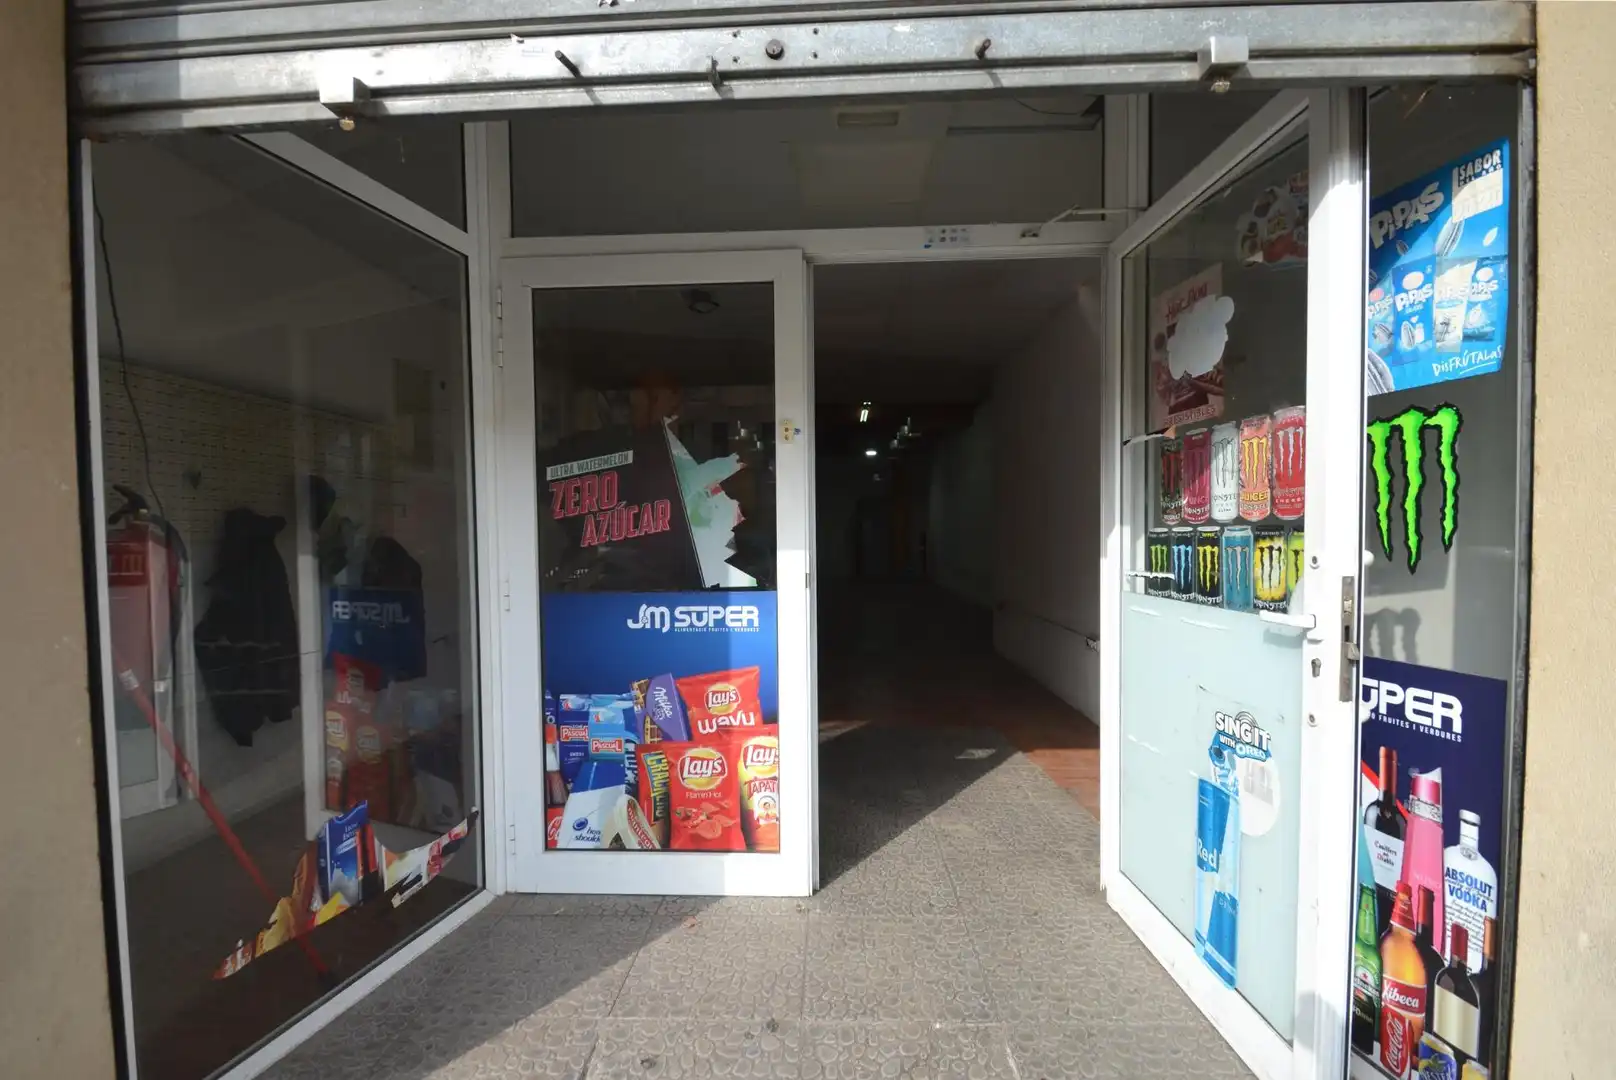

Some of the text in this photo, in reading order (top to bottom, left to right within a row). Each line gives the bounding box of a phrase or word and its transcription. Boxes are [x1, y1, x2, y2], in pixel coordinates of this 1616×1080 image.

[1459, 149, 1501, 181] SABOR
[550, 452, 629, 478] ULTRA WATERMELON
[549, 470, 618, 519] ZERO
[580, 499, 671, 547] AZÚCAR
[674, 605, 760, 627] SUPER
[653, 686, 673, 718] Milka
[708, 688, 737, 708] Lay's
[1361, 677, 1463, 734] UPER
[1215, 711, 1271, 752] SING IT
[1378, 714, 1410, 729] FRUITES
[1419, 725, 1462, 742] VERDURES
[1219, 733, 1267, 761] WITH OREO
[683, 756, 723, 778] Lay's
[1445, 866, 1493, 897] ABSOLUT
[1447, 883, 1488, 912] VODKA
[1382, 979, 1420, 1008] Xibeca
